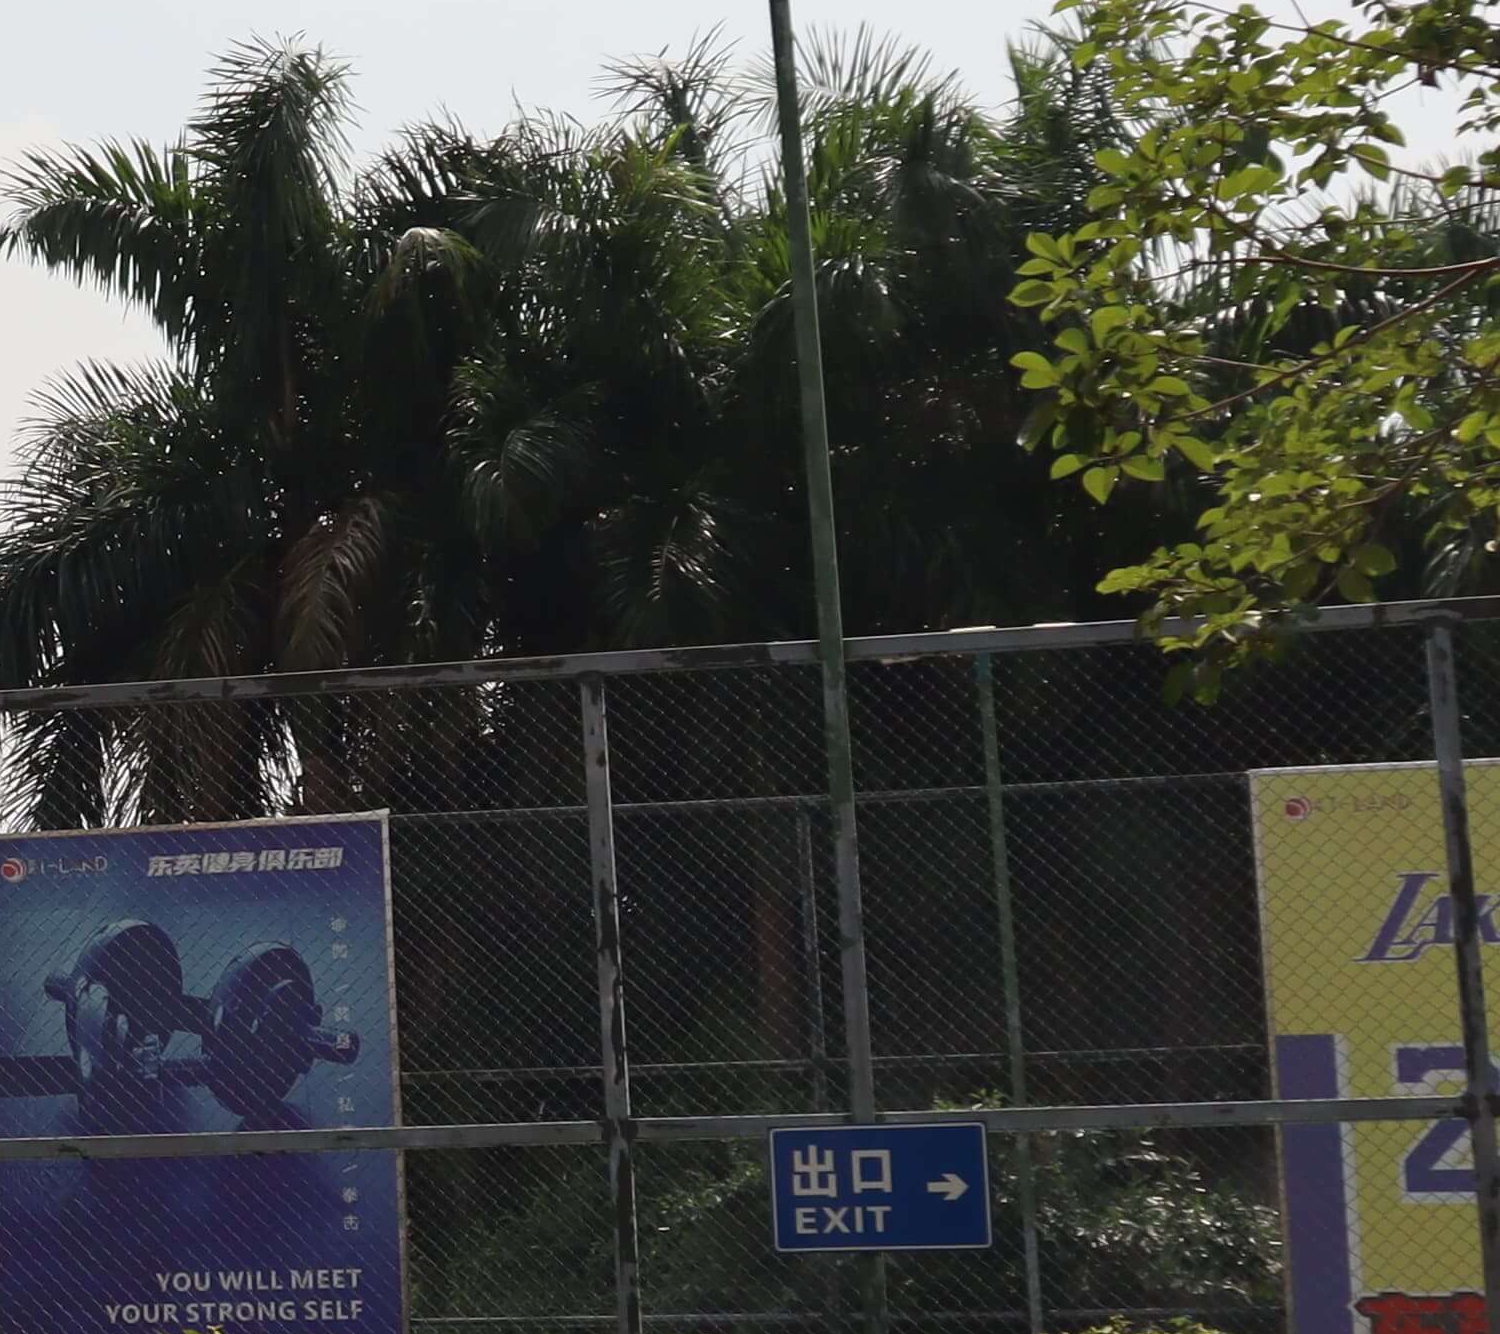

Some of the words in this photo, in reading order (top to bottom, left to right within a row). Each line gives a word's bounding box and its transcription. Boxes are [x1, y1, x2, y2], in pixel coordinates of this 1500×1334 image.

[147, 846, 344, 877] 东英健身俱乐部
[792, 1144, 893, 1198] 出口
[795, 1205, 893, 1235] EXIT
[156, 1271, 211, 1292] YOU
[218, 1270, 283, 1291] WILL
[291, 1268, 363, 1290] MEET
[105, 1303, 179, 1324] YOUR
[186, 1301, 297, 1322] STRONG
[304, 1299, 363, 1321] SELF
